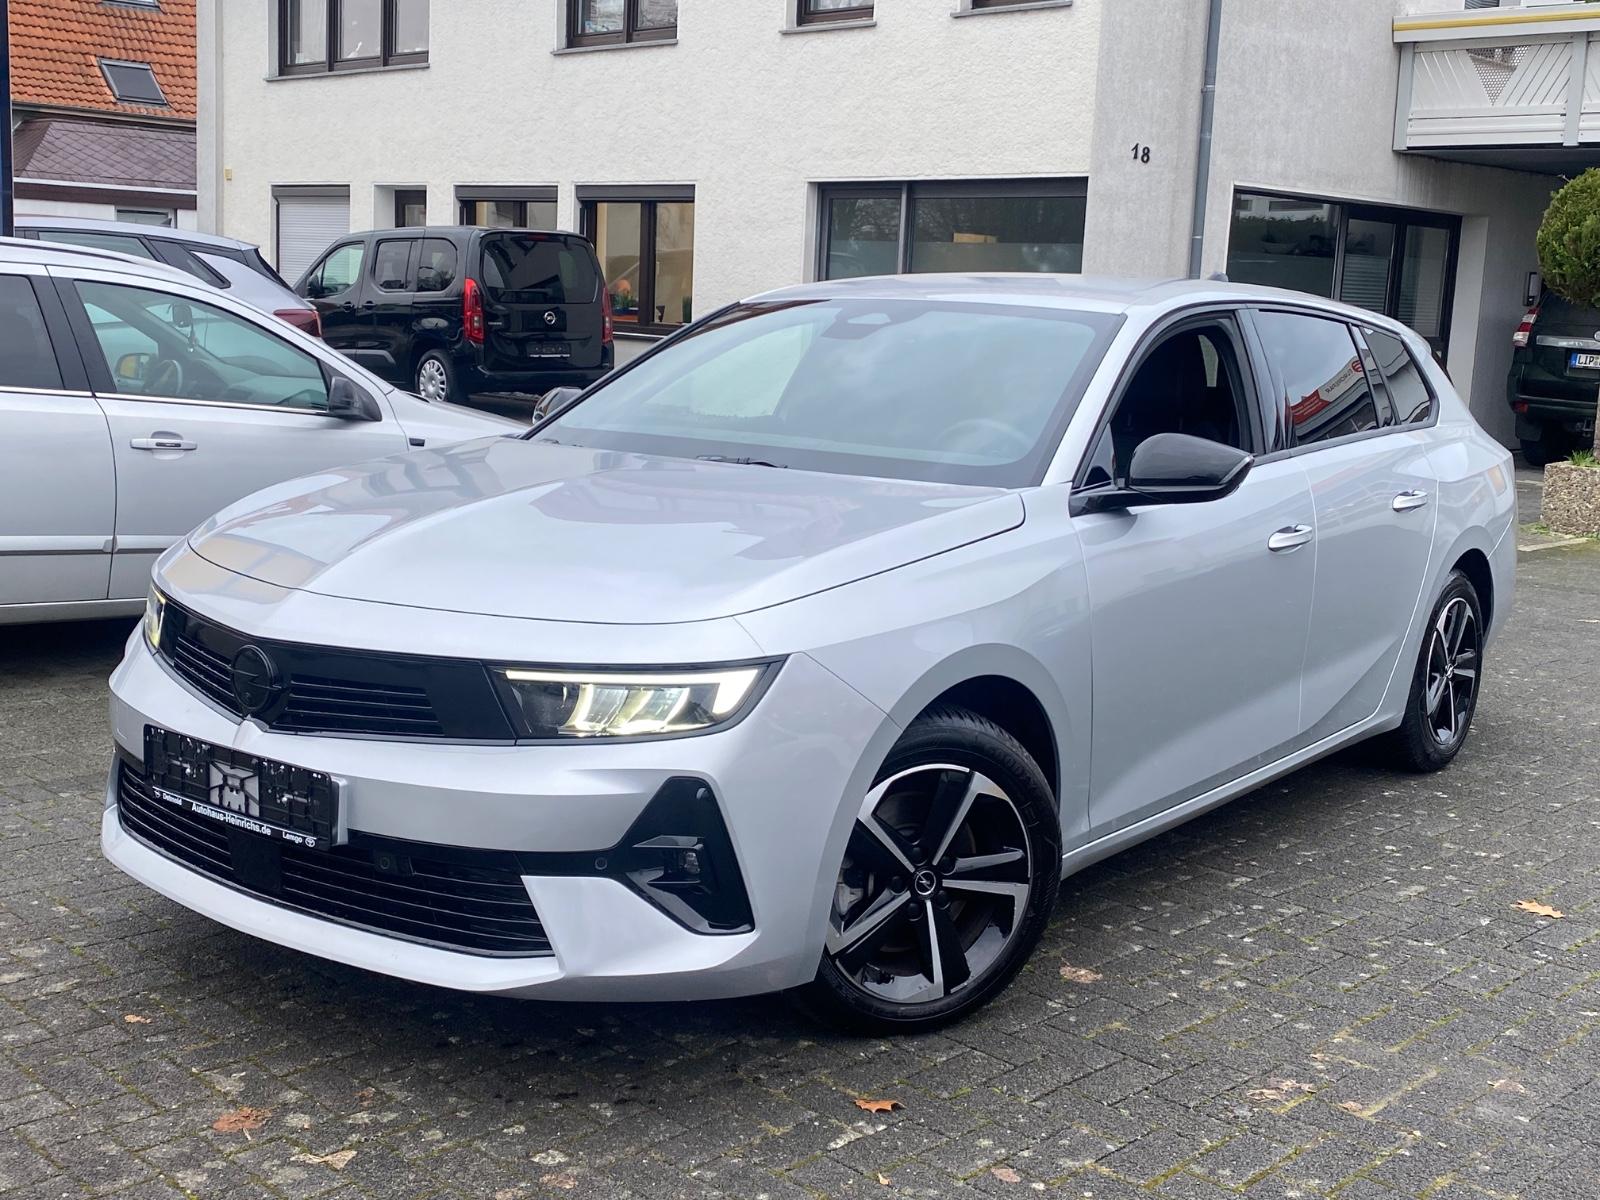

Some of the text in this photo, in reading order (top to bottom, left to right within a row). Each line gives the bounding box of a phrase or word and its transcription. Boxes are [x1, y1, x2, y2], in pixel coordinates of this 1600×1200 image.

[1131, 143, 1150, 164] 18
[1577, 355, 1595, 365] LIP
[192, 801, 272, 836] Autohaus-Heinrichs.de
[282, 831, 303, 844] Lemgo
